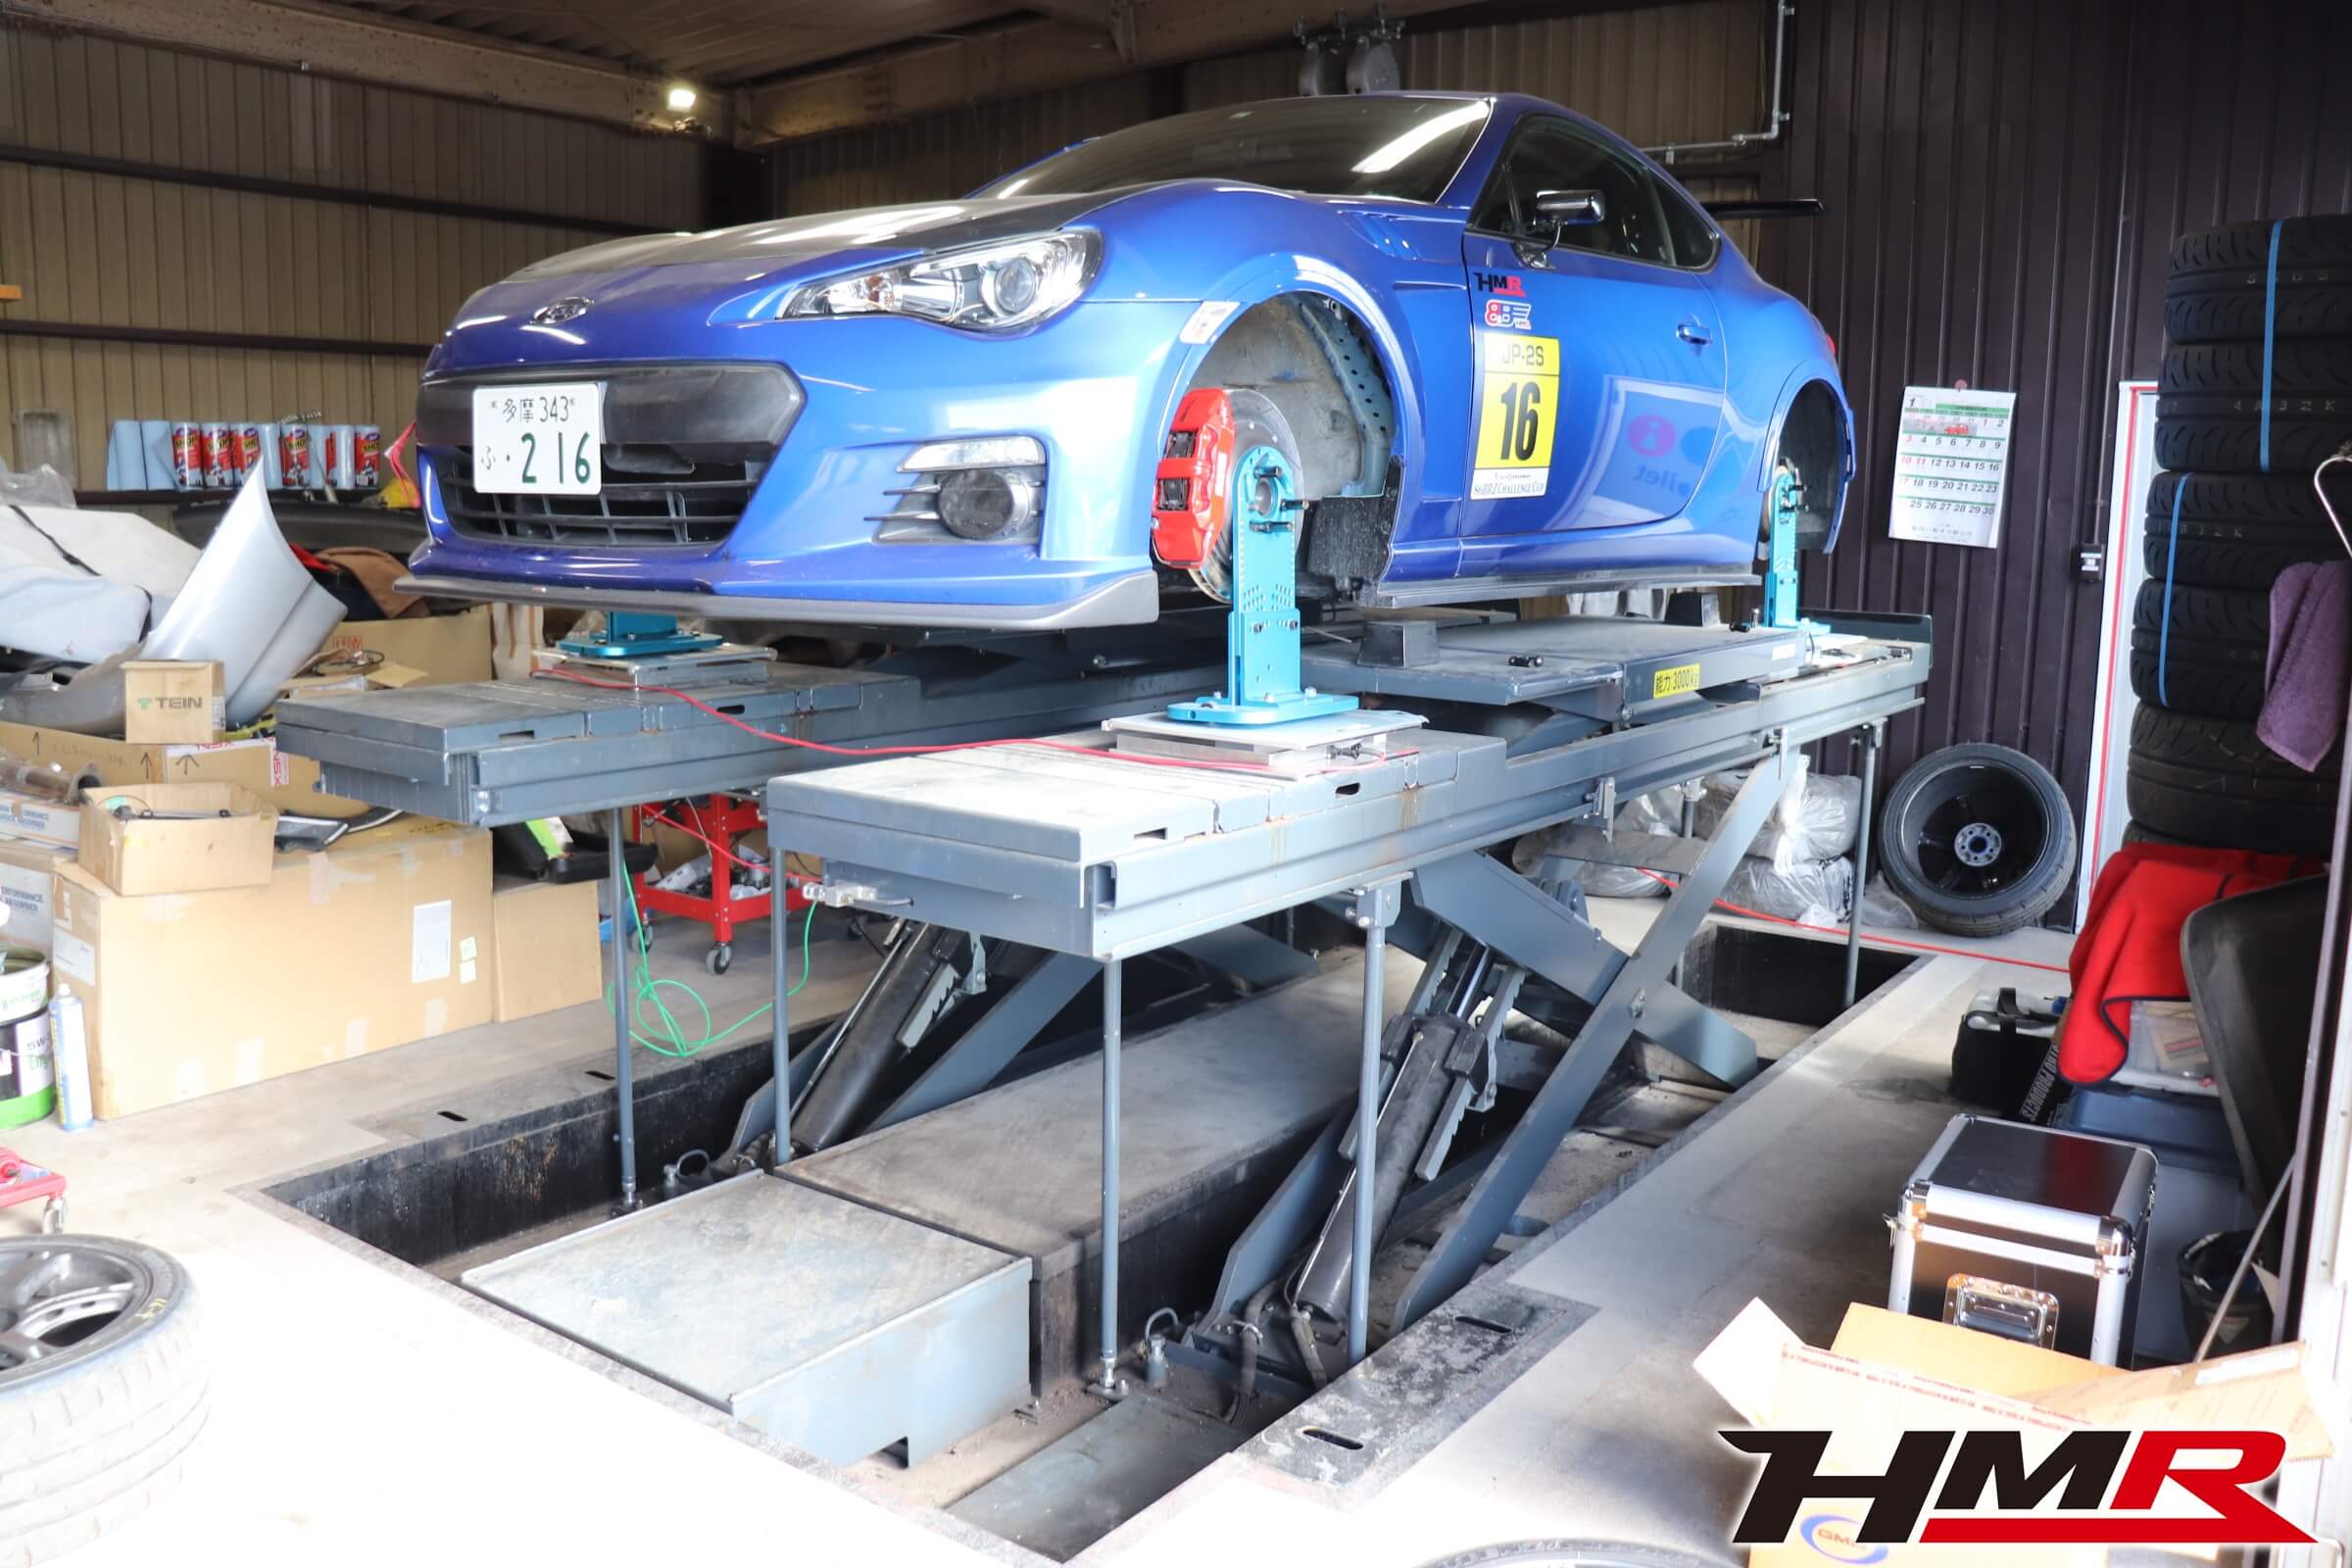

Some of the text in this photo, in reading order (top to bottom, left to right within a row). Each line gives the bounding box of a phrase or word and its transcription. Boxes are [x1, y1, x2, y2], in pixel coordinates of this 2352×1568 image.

[1474, 273, 1526, 297] HMR
[1502, 344, 1544, 367] JP-2S
[503, 396, 569, 422] 多摩 343
[1500, 382, 1541, 461] 16
[481, 446, 496, 470] ふ
[1975, 462, 1984, 470] 15
[1971, 483, 1984, 492] 22
[1953, 504, 1965, 513] 28
[1982, 507, 1993, 515] 30
[155, 697, 203, 709] TEIN
